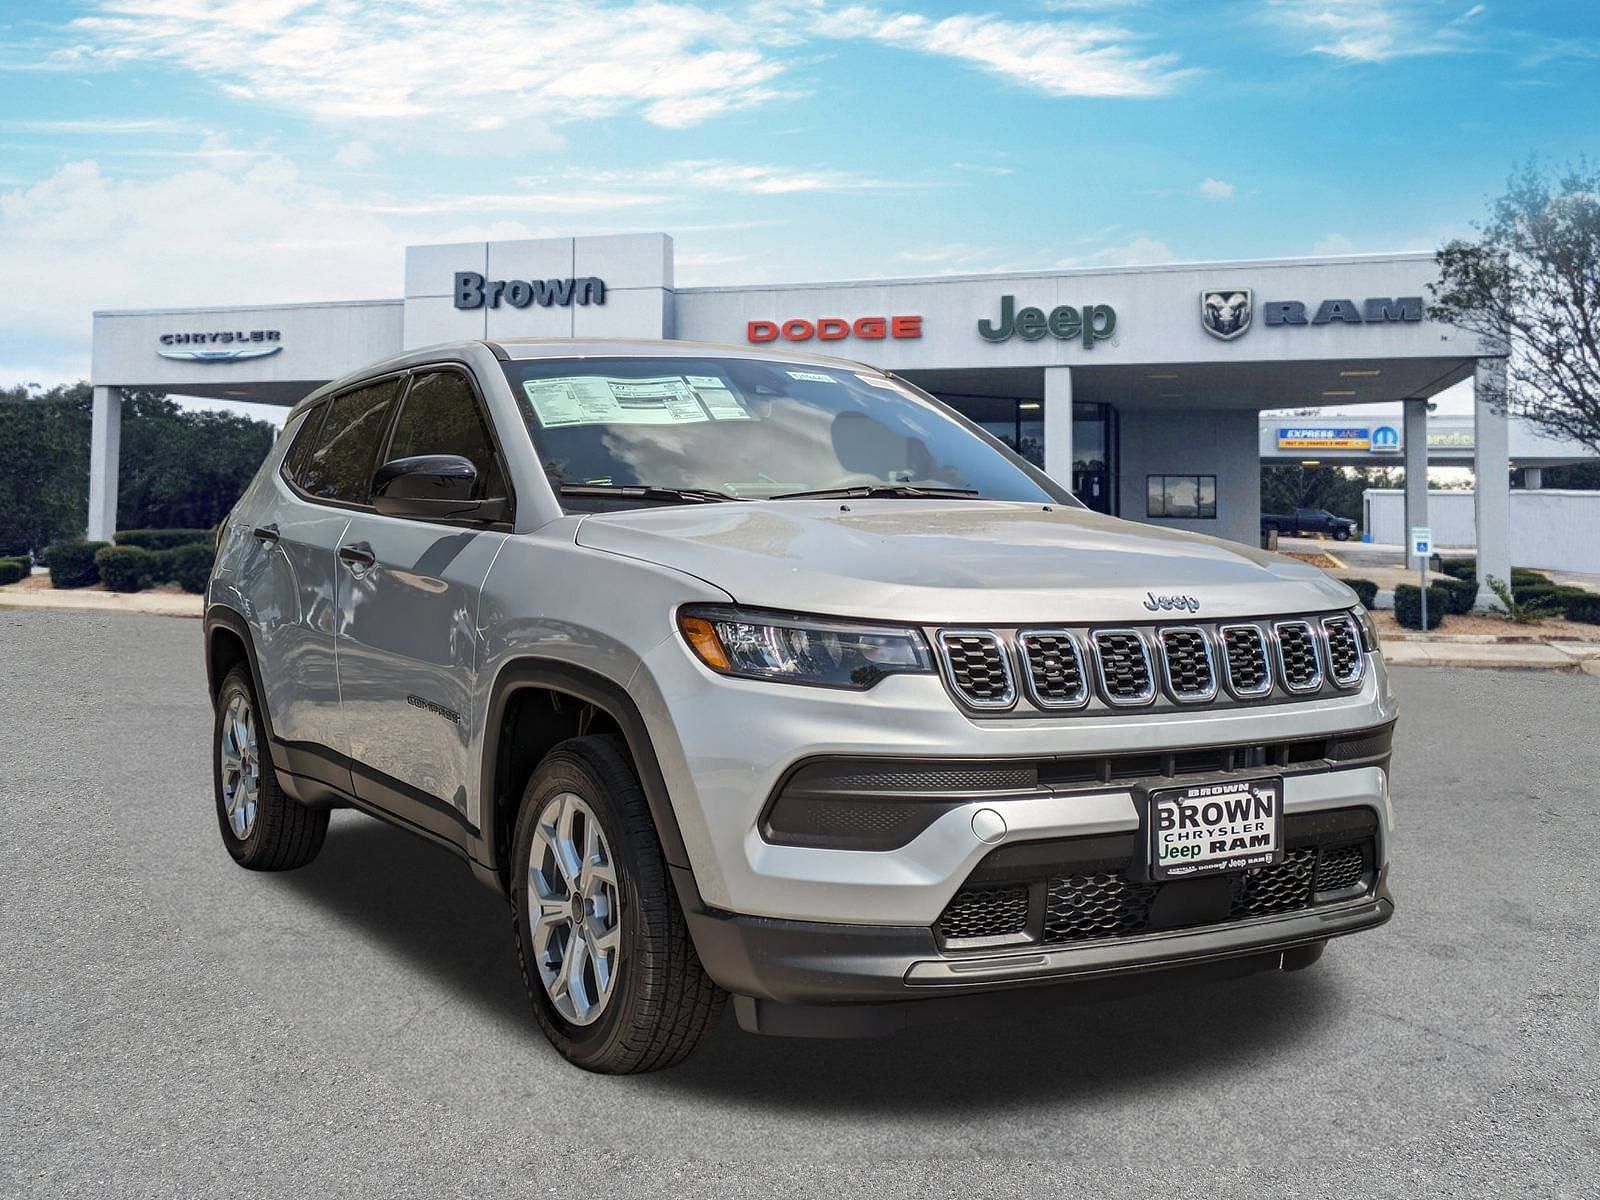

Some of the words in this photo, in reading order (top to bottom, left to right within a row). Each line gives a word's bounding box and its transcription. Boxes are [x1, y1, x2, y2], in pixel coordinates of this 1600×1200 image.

[454, 271, 607, 310] Brown
[978, 295, 1117, 350] Jeep
[1264, 297, 1423, 326] RAM
[159, 328, 281, 346] CHRYSLER
[747, 315, 923, 343] DODGE
[1143, 592, 1200, 613] Jeep
[1188, 783, 1249, 798] BROWN
[1158, 795, 1273, 831] BROWN
[1164, 822, 1265, 843] CHRYSLER
[1159, 844, 1202, 859] Jeep
[1209, 834, 1270, 854] RAM
[1228, 858, 1246, 867] Jeep
